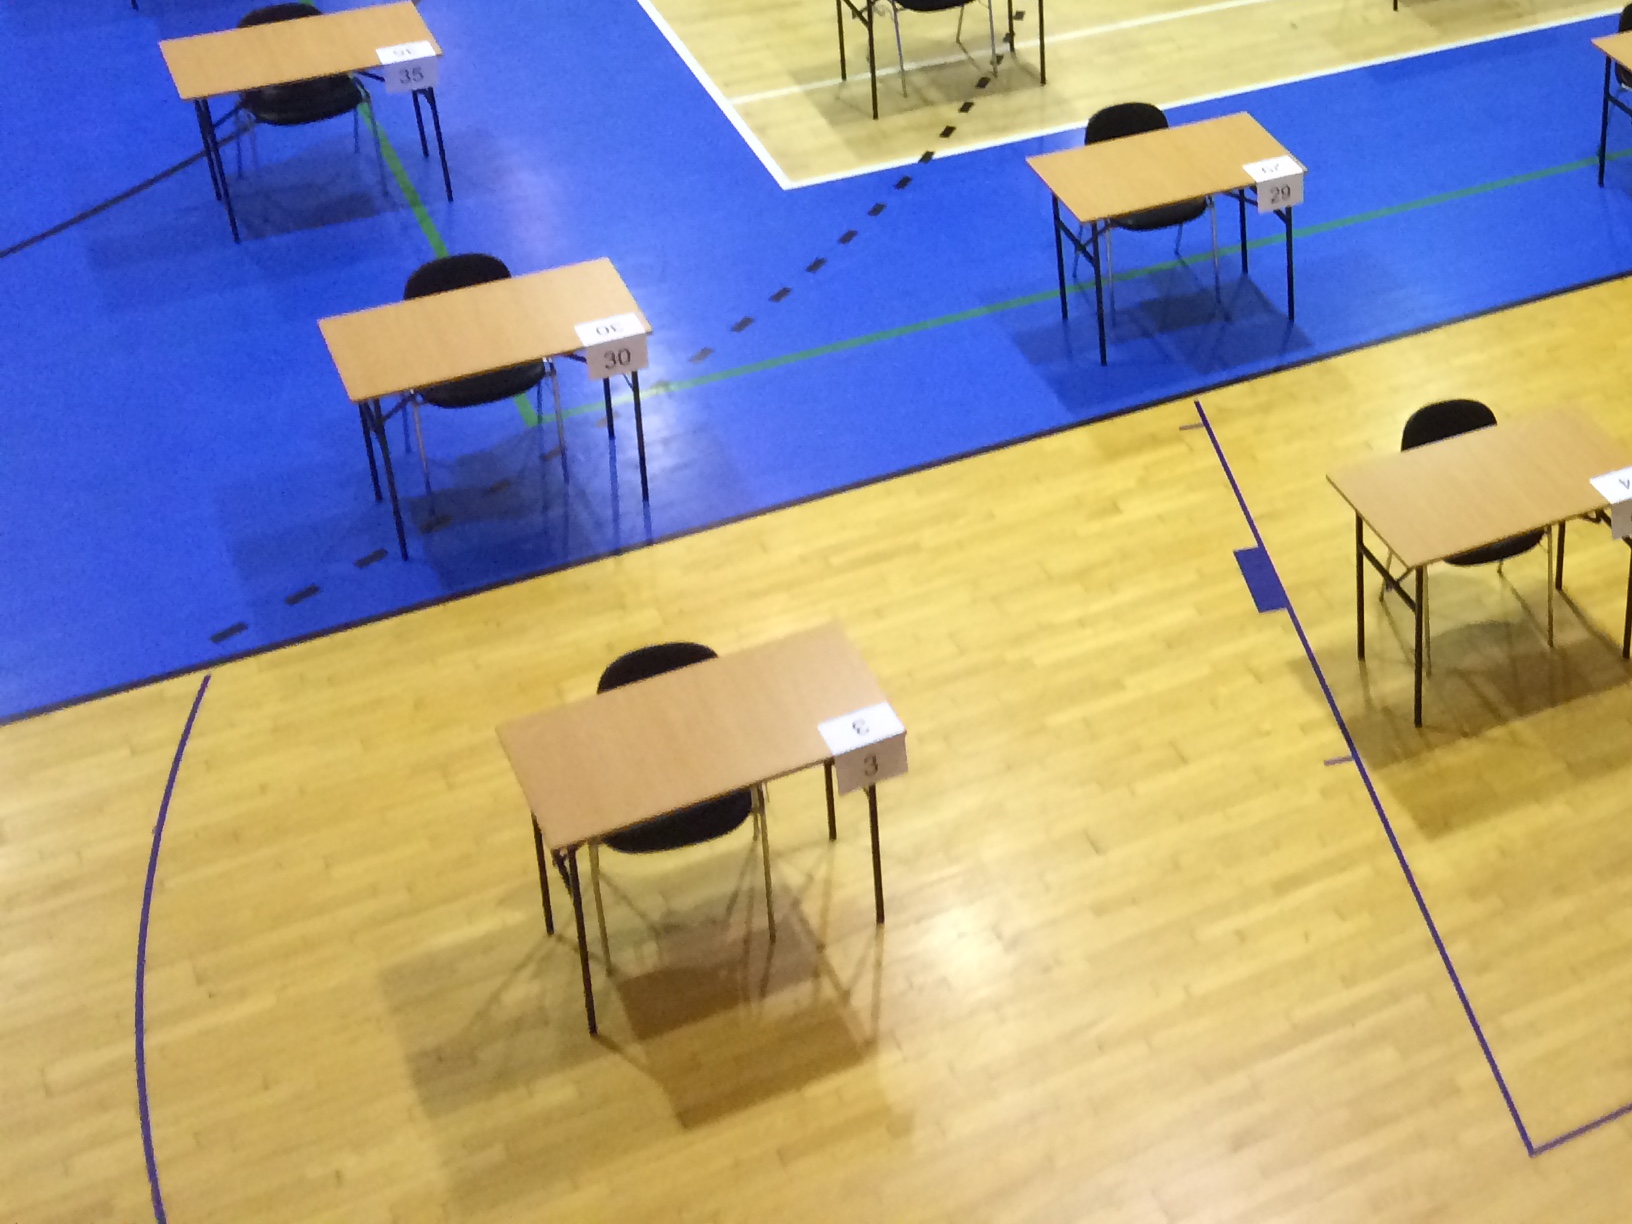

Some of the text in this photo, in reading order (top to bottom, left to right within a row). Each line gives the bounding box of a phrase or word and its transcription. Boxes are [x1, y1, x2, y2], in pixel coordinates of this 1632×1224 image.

[399, 67, 424, 84] 35
[1270, 184, 1291, 204] 29
[604, 348, 631, 370] 30
[864, 753, 879, 777] 3
